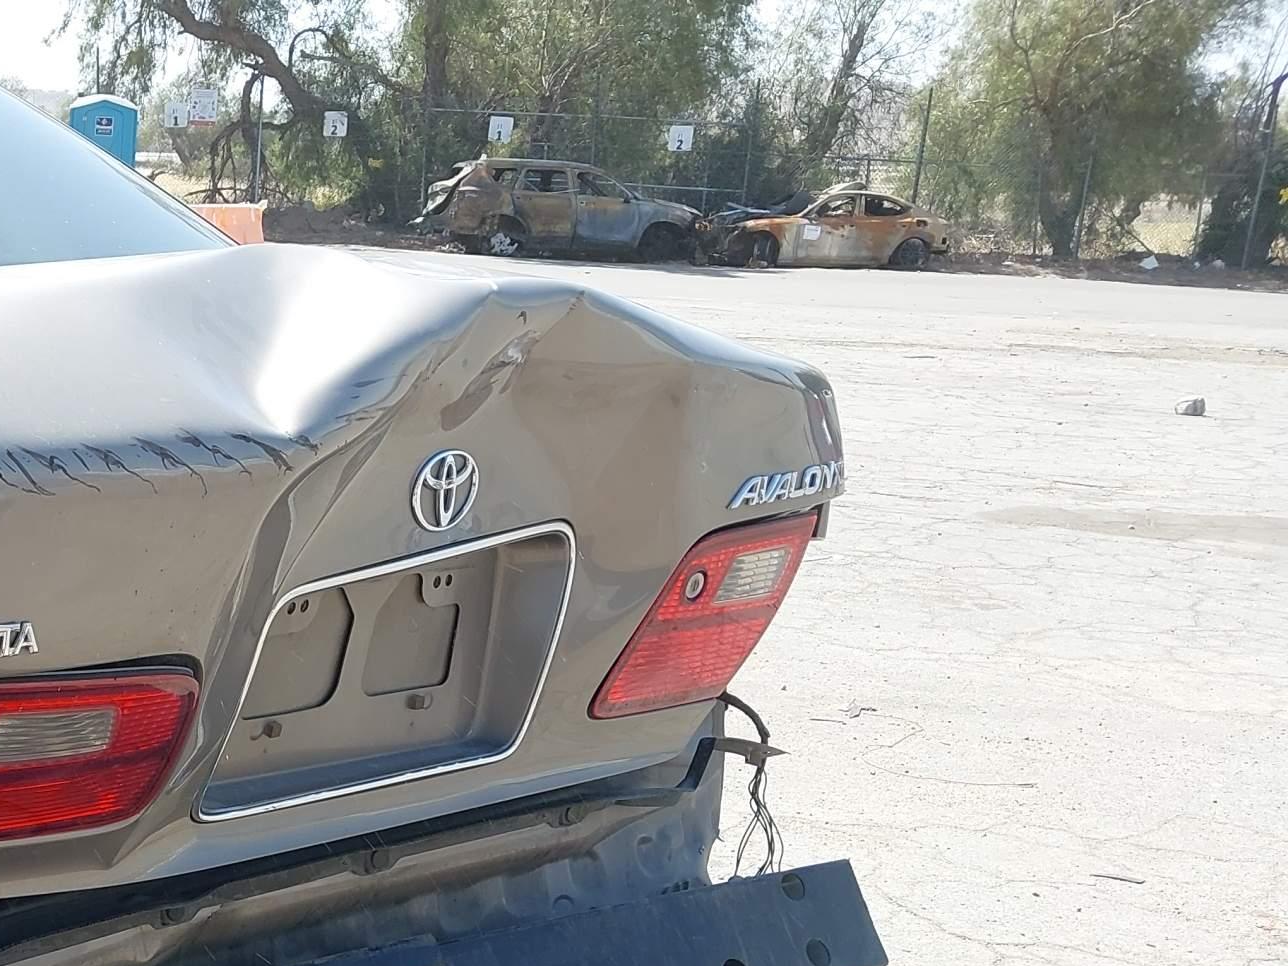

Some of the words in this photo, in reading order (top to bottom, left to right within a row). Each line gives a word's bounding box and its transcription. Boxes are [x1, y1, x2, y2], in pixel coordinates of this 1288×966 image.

[331, 124, 338, 135] 2
[496, 130, 502, 141] 1
[676, 139, 683, 150] 2
